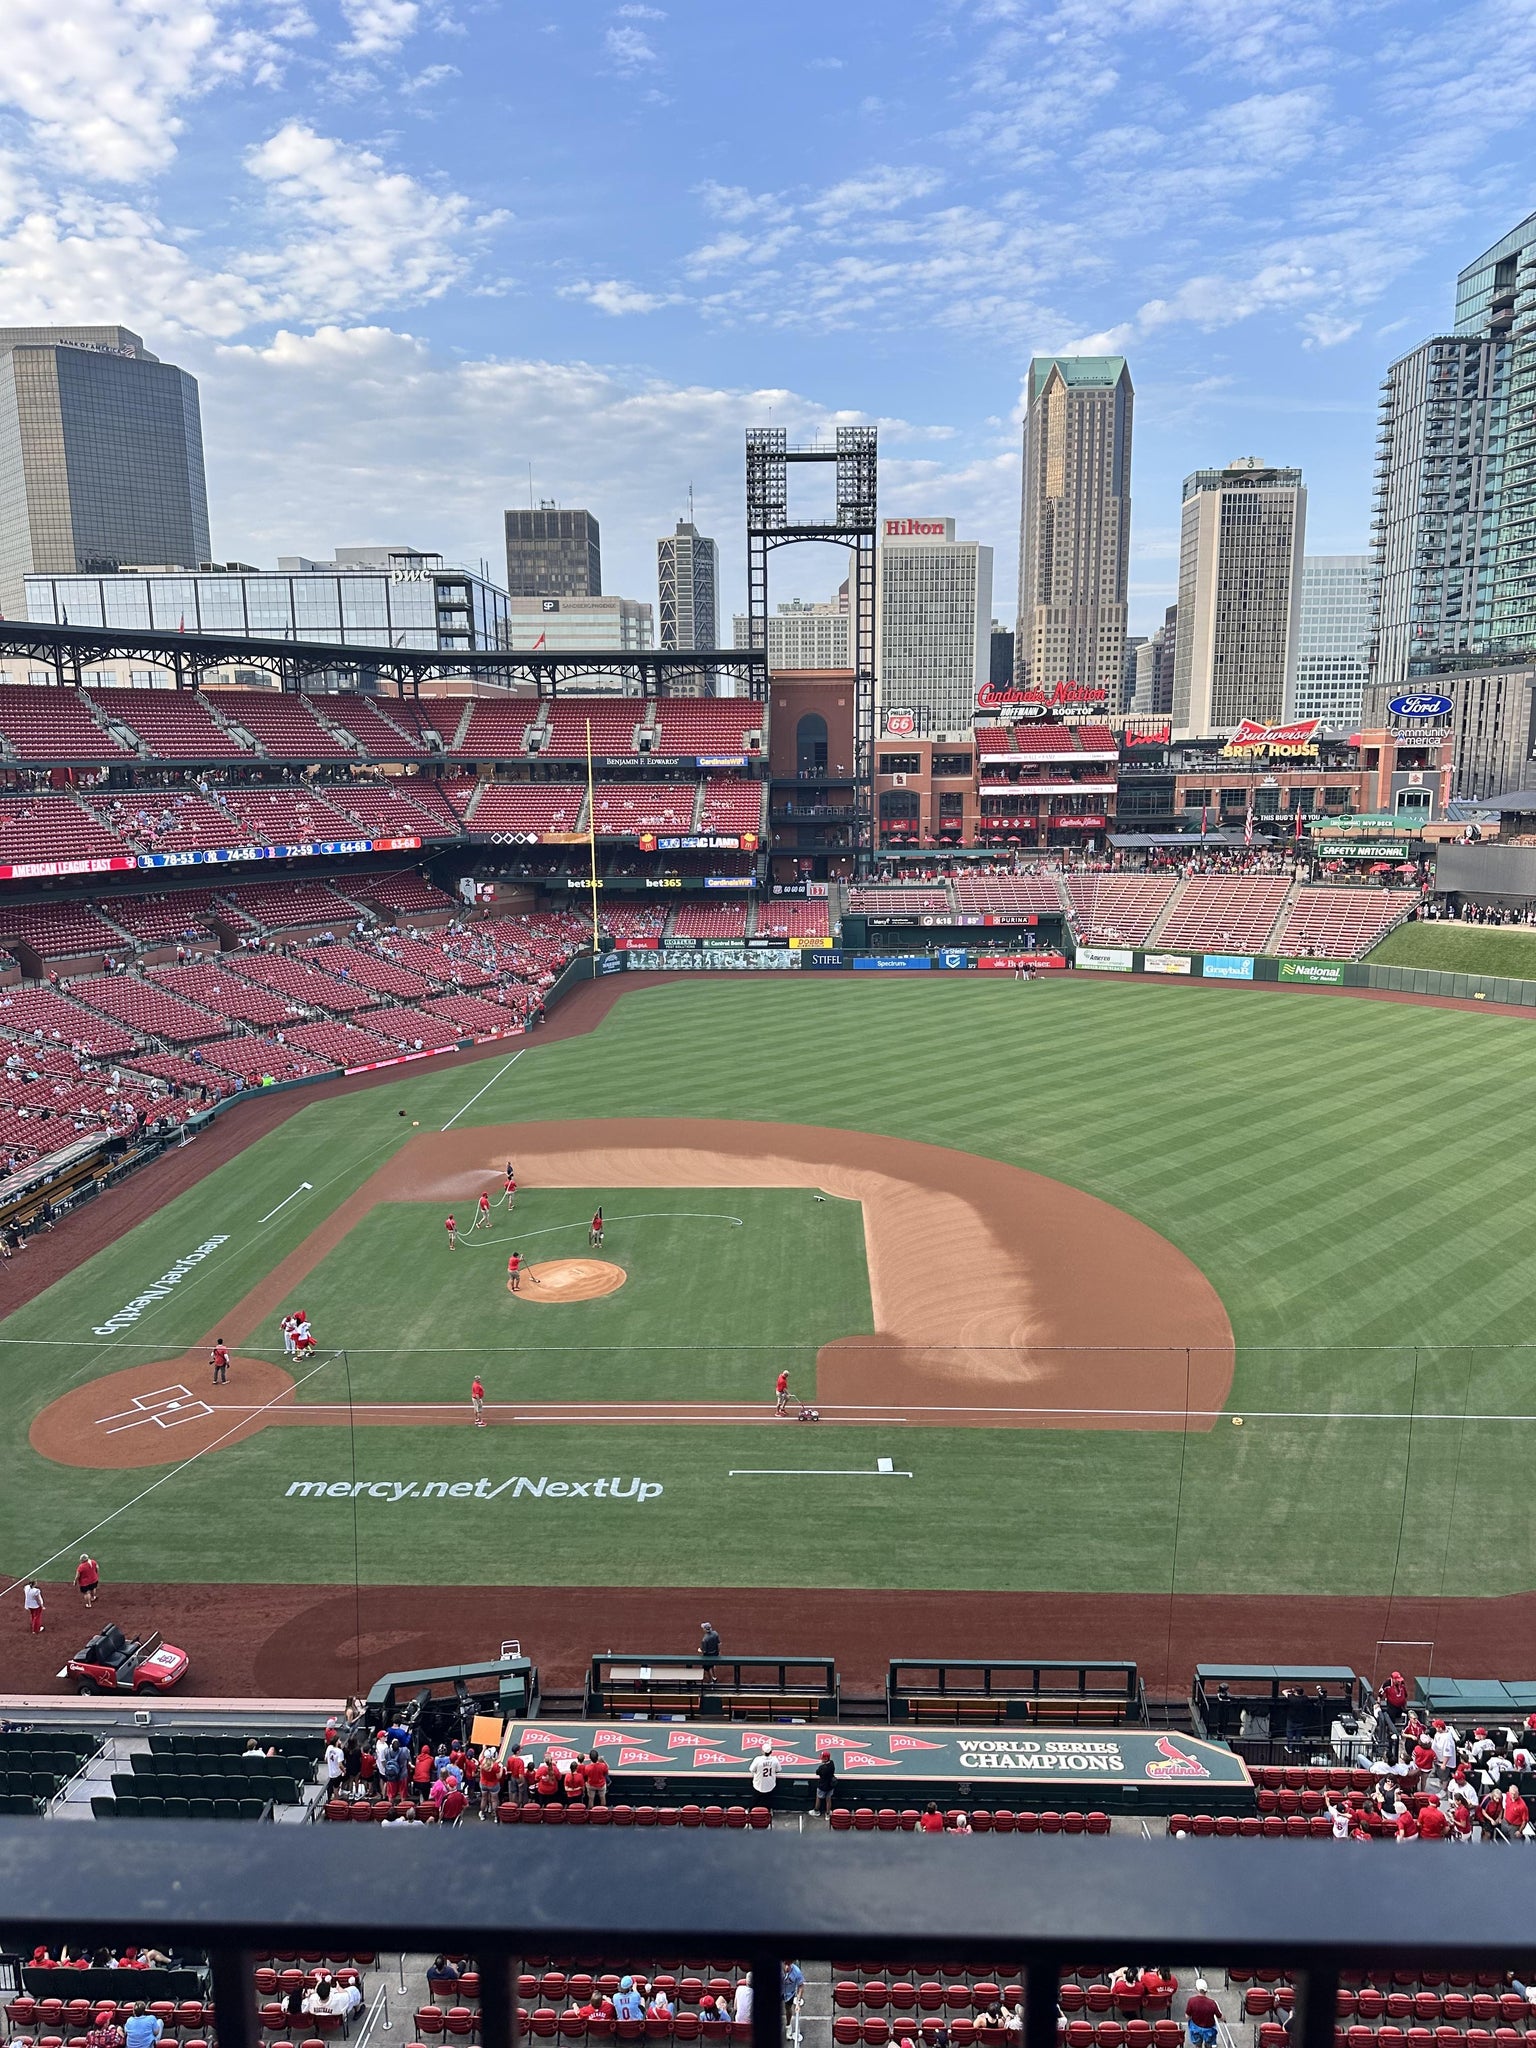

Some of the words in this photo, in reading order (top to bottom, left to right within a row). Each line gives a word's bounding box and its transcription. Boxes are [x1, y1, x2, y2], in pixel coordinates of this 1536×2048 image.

[886, 519, 944, 535] Hilton
[391, 569, 431, 587] pwc
[978, 682, 1046, 708] Cardinals
[1045, 680, 1106, 706] Nation
[1401, 696, 1441, 713] Ford
[1000, 707, 1039, 716] HOFFMANN
[1052, 708, 1094, 716] ROOFTOP
[891, 719, 910, 730] 66
[1125, 727, 1169, 747] Live!
[1232, 728, 1317, 743] Budweiser
[1391, 728, 1451, 738] Community
[1223, 745, 1265, 757] BREW
[1269, 744, 1320, 756] HOUSE
[340, 841, 367, 852] 64-68
[391, 839, 415, 849] 63-68
[709, 837, 739, 848] LAND
[227, 849, 256, 860] 74-56
[286, 845, 313, 856] 72-59
[1322, 847, 1356, 855] SAFETY
[1357, 847, 1404, 856] NATIONAL
[163, 853, 195, 865] 78-53
[12, 863, 57, 876] AMERICAN
[59, 861, 90, 873] LEAGUE
[91, 859, 111, 870] EAST
[645, 879, 682, 887] bet365
[936, 917, 952, 925] 6:15
[812, 954, 842, 965] STIFEL
[1295, 965, 1340, 977] National
[91, 1234, 231, 1335] mercy.net/NextUp
[285, 1476, 664, 1502] mercy.net/NextUp
[525, 1733, 551, 1742] 1926
[598, 1735, 623, 1744] 1934
[672, 1737, 699, 1745] 1944
[746, 1737, 772, 1746] 1964
[820, 1738, 845, 1746] 1982
[893, 1739, 916, 1747] 2011
[956, 1741, 1041, 1752] WORLD
[1045, 1743, 1120, 1754] SERIES
[551, 1750, 572, 1759] 1931
[623, 1752, 649, 1761] 1942
[698, 1753, 725, 1763] 1946
[847, 1755, 876, 1766] 2006
[959, 1754, 1125, 1771] CHAMPIONS
[763, 1767, 772, 1777] 21
[1146, 1761, 1210, 1778] Cardinals
[622, 2006, 630, 2020] 0
